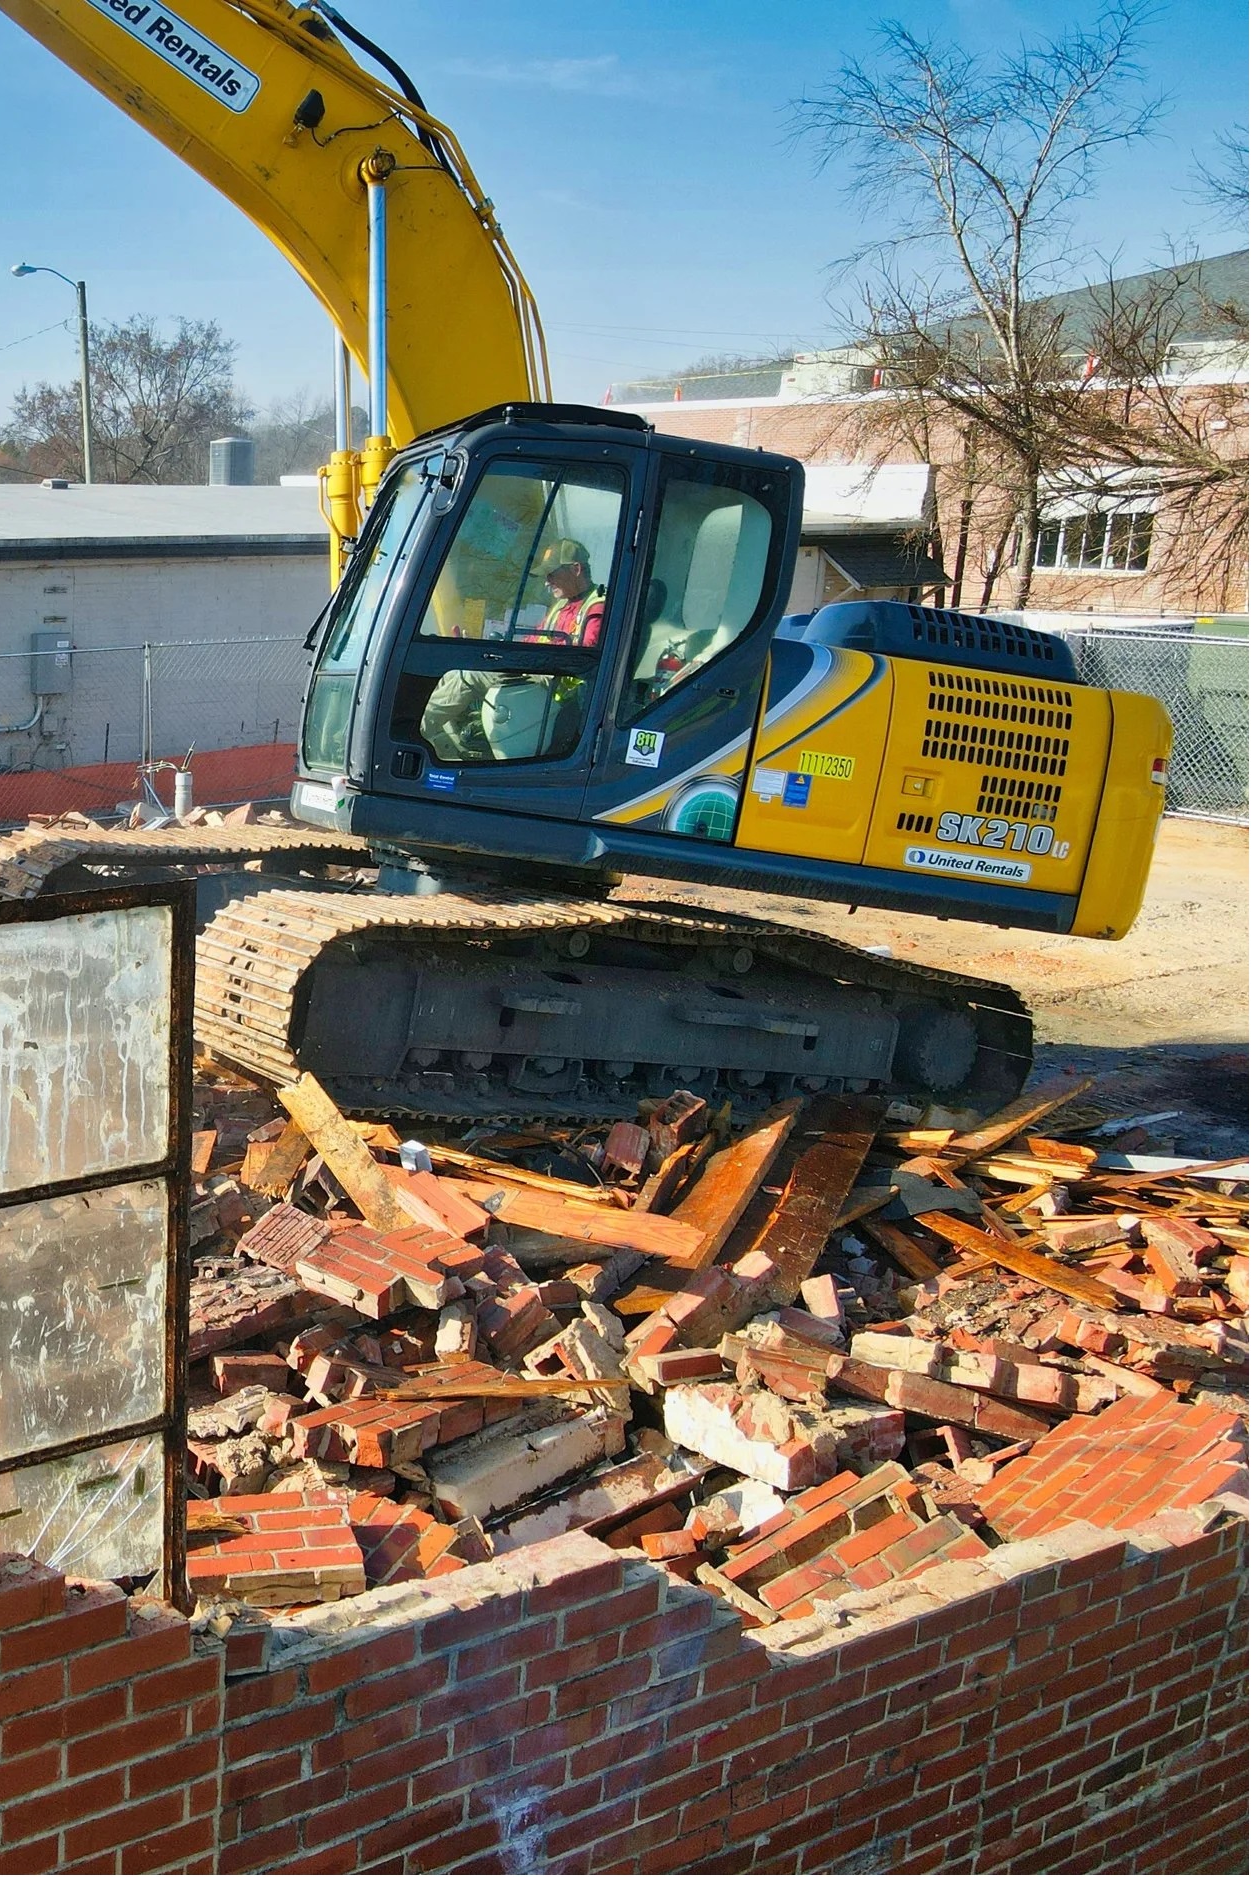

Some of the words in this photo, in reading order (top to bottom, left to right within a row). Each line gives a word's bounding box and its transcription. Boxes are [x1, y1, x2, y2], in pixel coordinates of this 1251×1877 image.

[146, 15, 241, 97] Rentals
[636, 731, 656, 748] 811
[800, 752, 852, 778] 11112350
[937, 811, 1054, 855] SK210
[1051, 840, 1070, 859] LC
[928, 852, 972, 870] United
[975, 860, 1024, 878] Rentals
